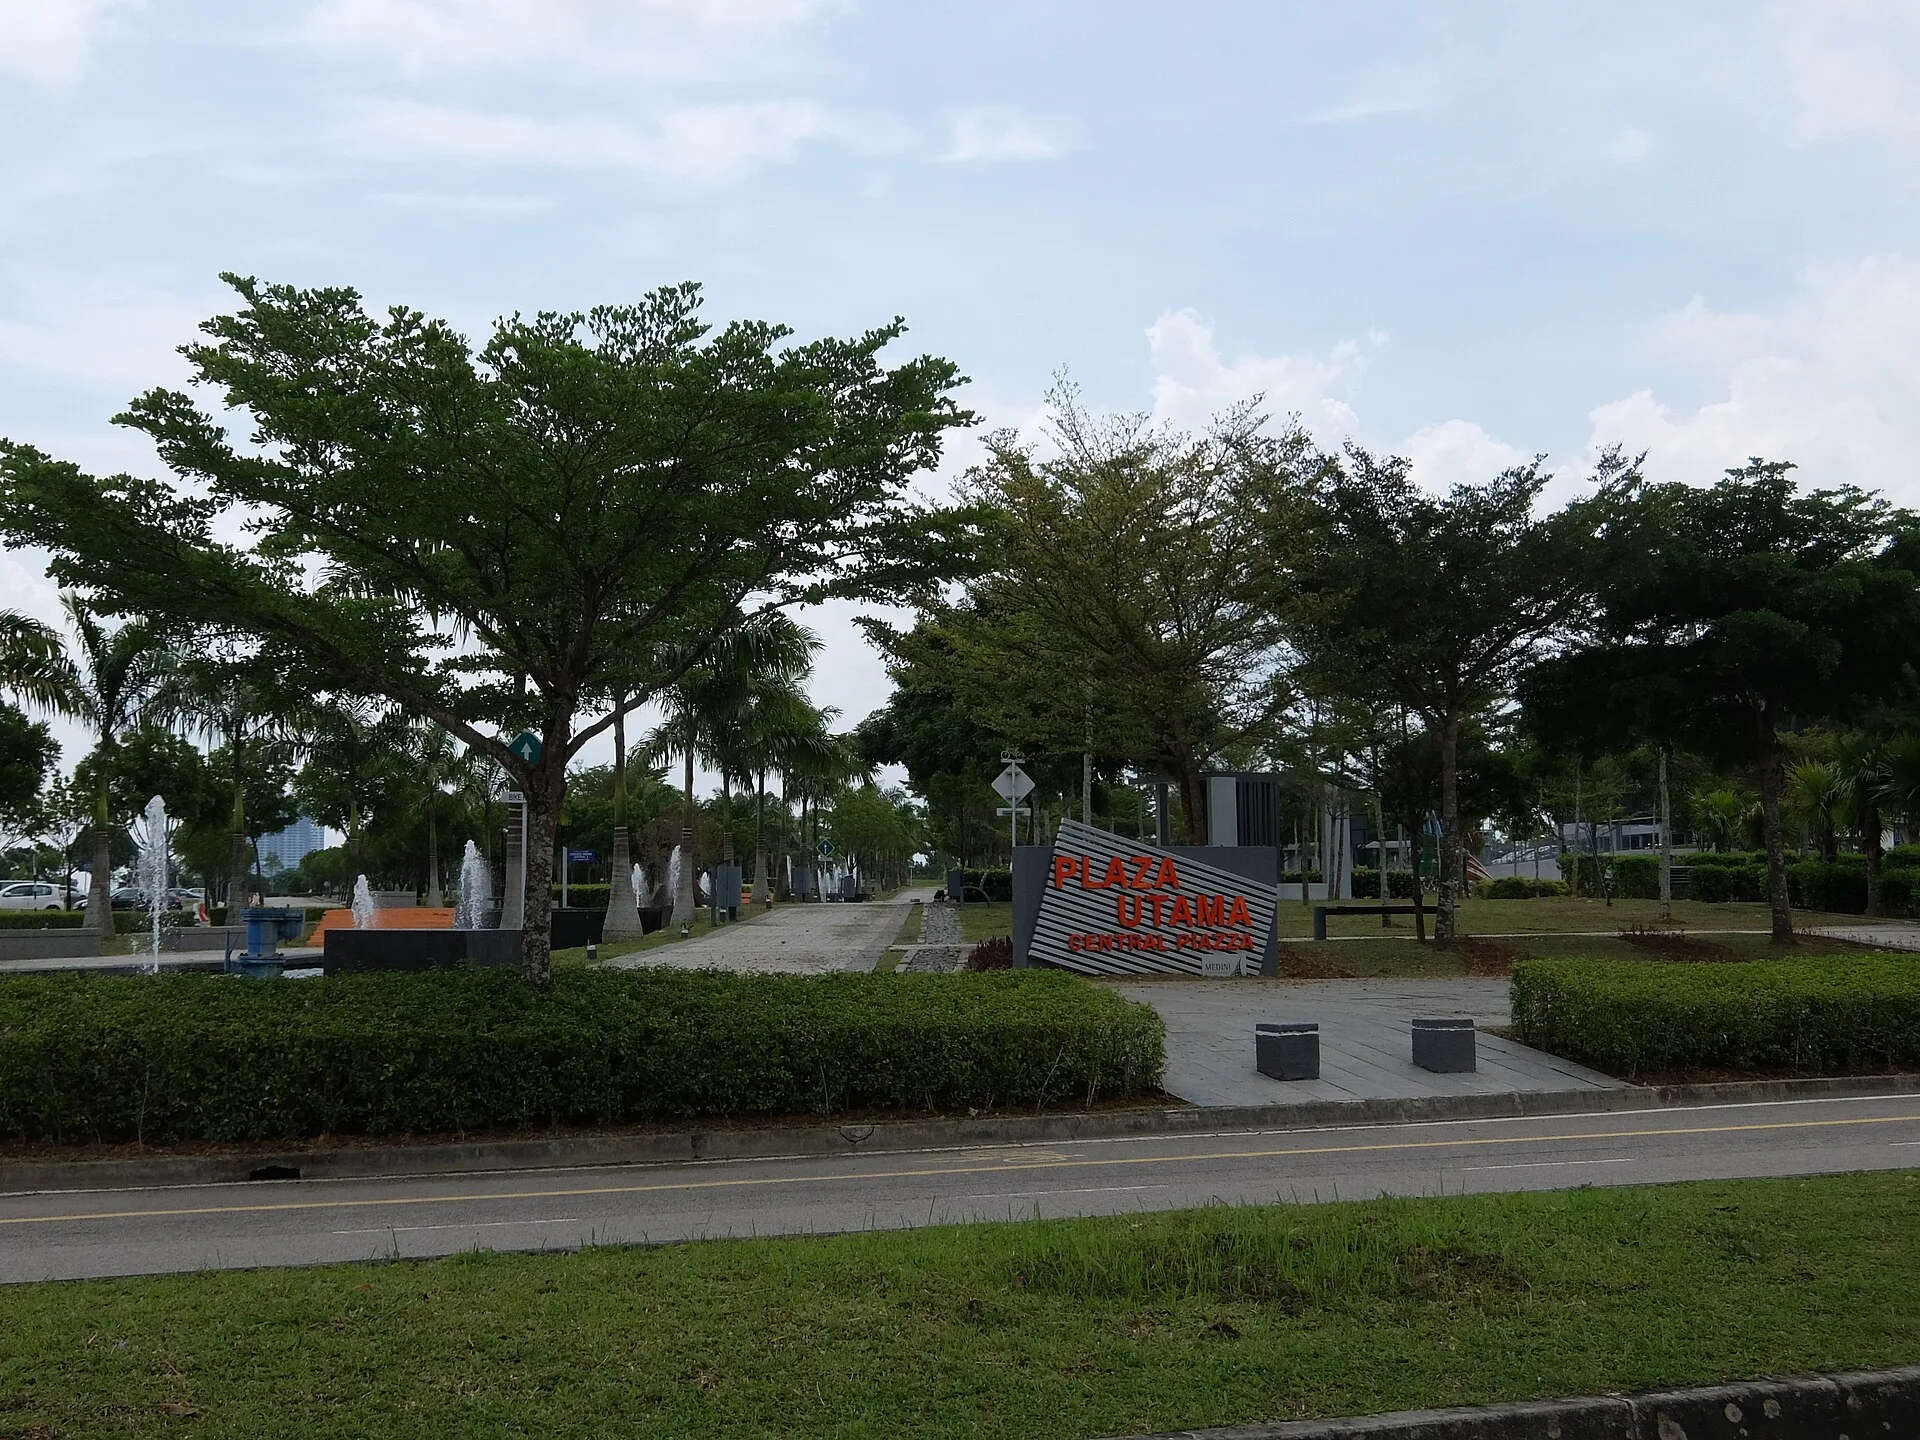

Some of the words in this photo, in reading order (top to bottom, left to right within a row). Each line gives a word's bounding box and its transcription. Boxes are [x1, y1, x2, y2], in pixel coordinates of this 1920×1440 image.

[508, 793, 522, 801] BIKE
[1054, 855, 1181, 890] PLAZA
[1117, 894, 1253, 928] UTAMA
[1068, 933, 1169, 951] CENTRAL
[1176, 933, 1255, 951] PIAZZA
[1205, 963, 1231, 971] MEDINI
